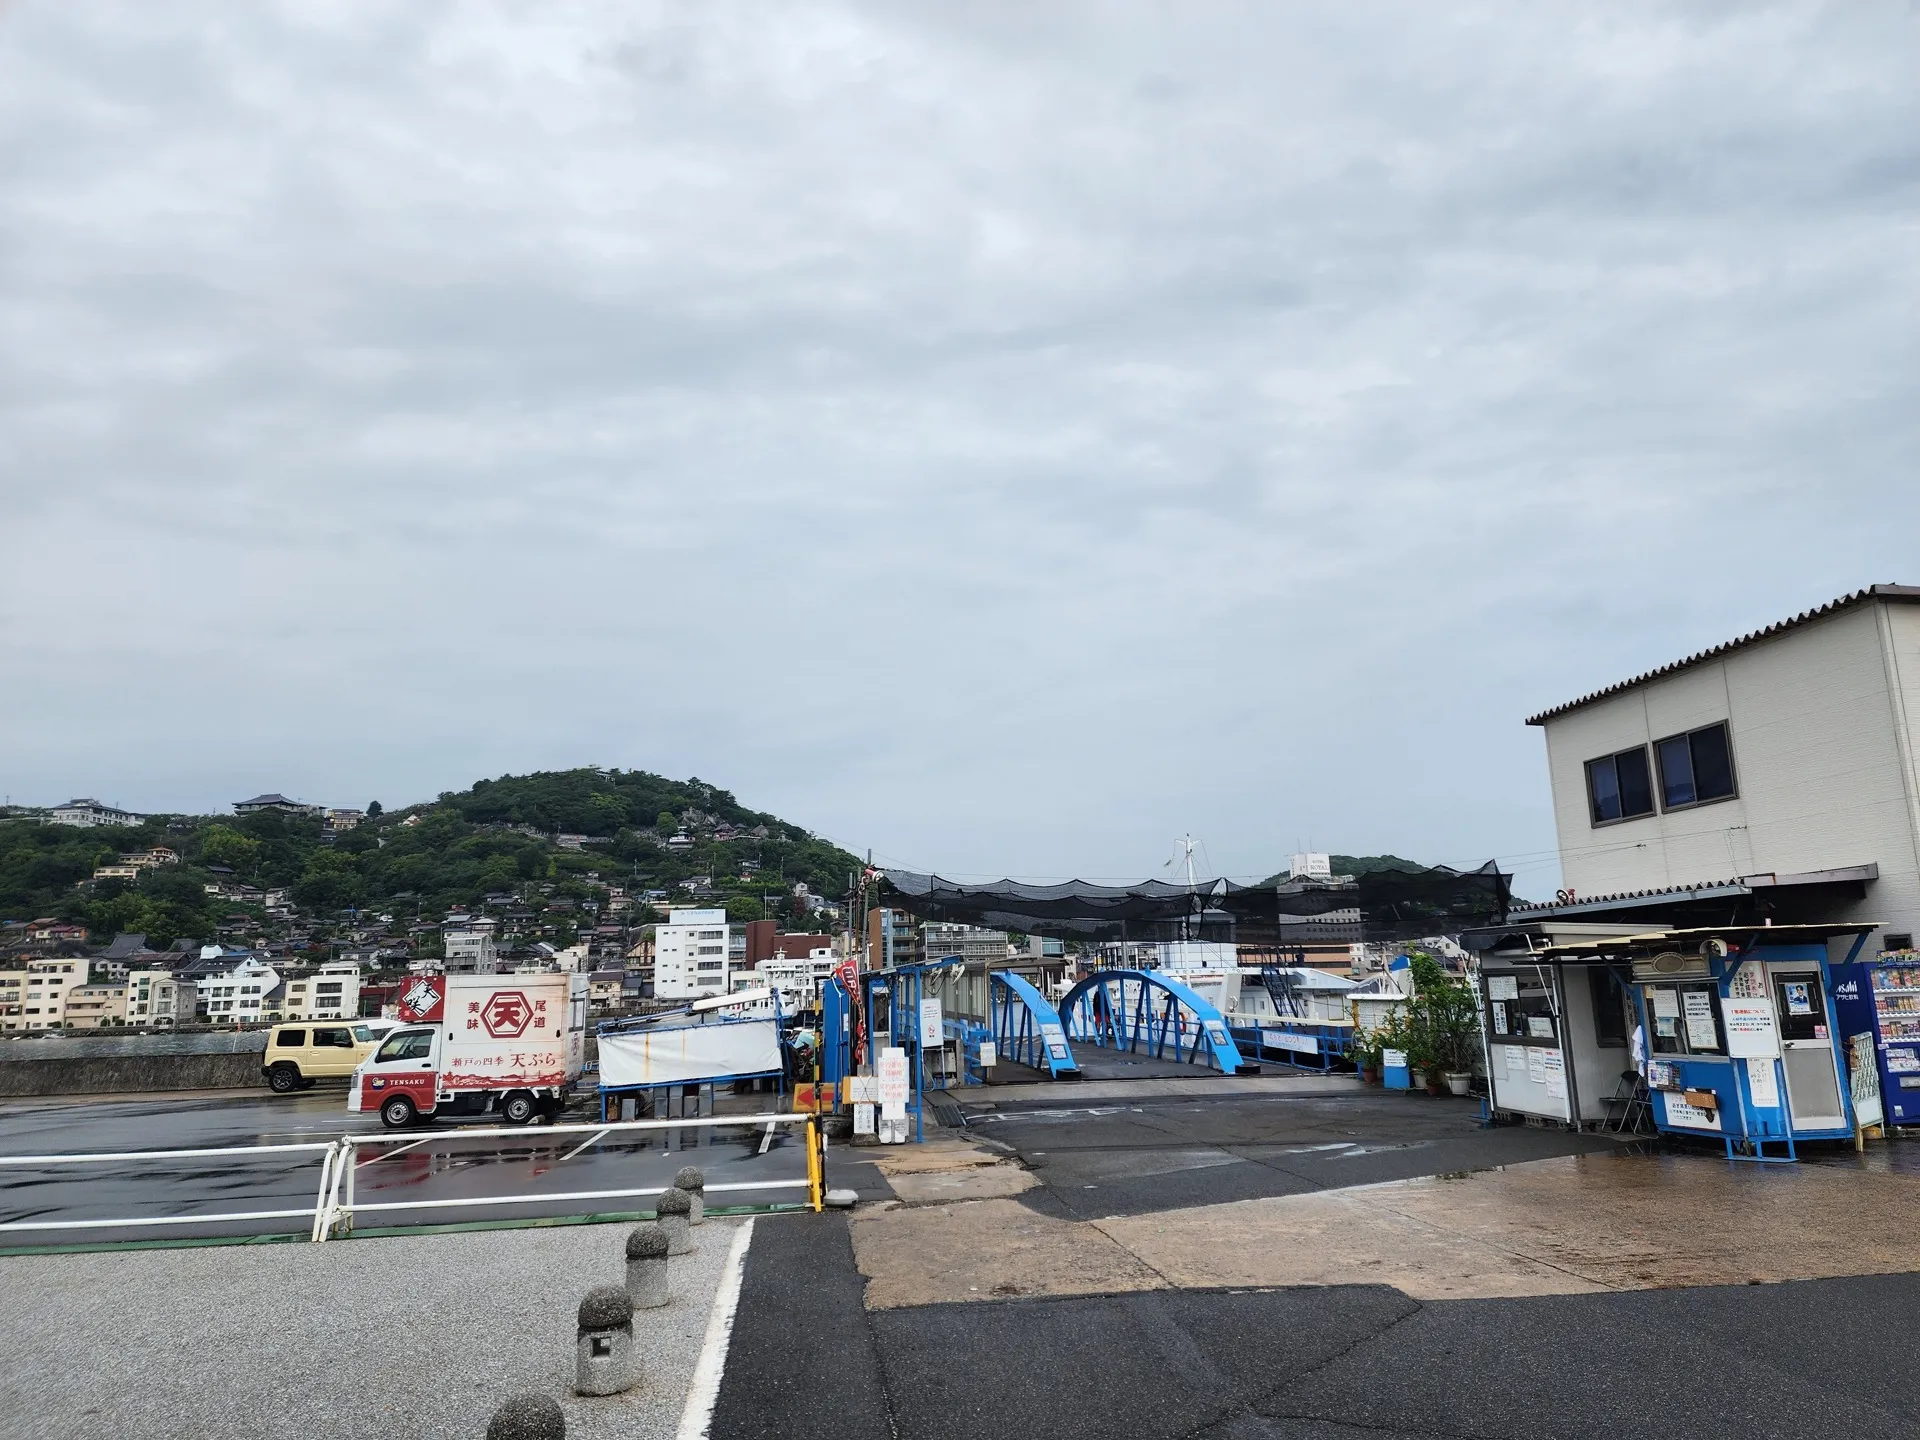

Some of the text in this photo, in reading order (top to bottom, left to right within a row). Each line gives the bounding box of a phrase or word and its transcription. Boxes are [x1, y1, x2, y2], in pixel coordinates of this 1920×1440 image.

[1836, 980, 1858, 993] Asahi
[467, 1002, 480, 1030] 美味
[533, 1000, 547, 1028] 尾道
[452, 1056, 504, 1067] 瀬戸の四季
[510, 1053, 556, 1068] 天ぷら
